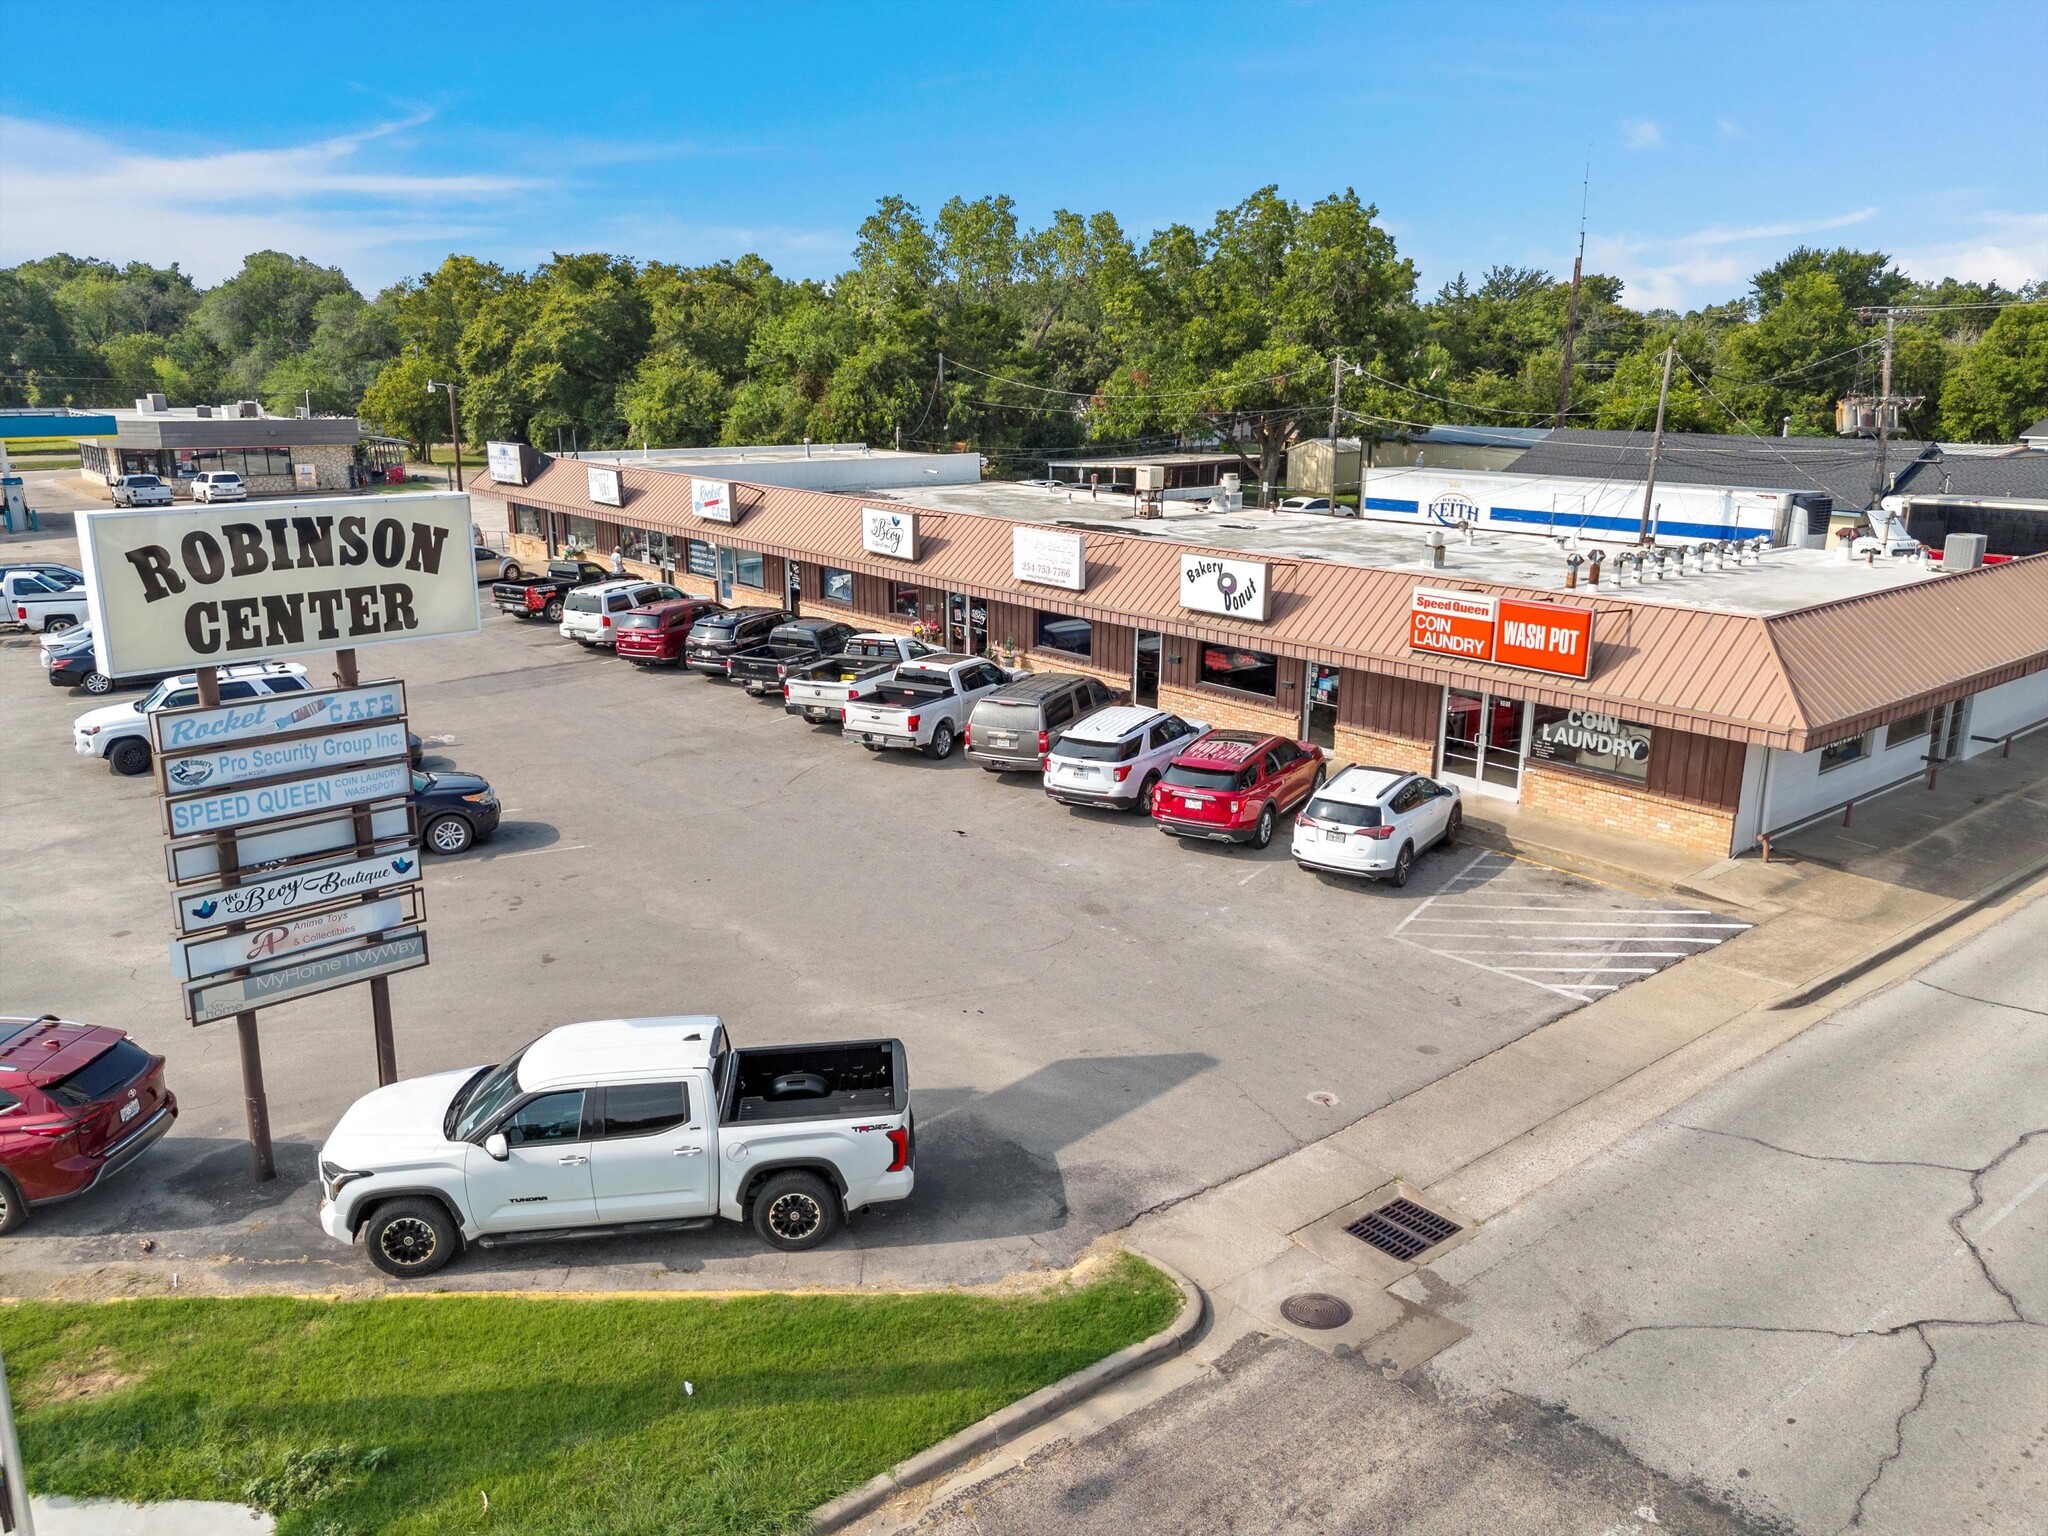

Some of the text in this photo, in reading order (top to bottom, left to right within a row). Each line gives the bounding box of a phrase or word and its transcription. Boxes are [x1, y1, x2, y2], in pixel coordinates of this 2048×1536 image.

[700, 484, 723, 501] Rocket
[1427, 502, 1479, 522] KEITH
[871, 517, 904, 554] Bevy
[125, 515, 449, 603] ROBINSON
[1022, 562, 1071, 578] 254-753-7766
[1186, 561, 1223, 584] Bakery
[1224, 578, 1256, 611] Donut
[1417, 597, 1489, 616] Speed Queen
[184, 583, 419, 655] CENTER
[1415, 614, 1451, 633] COIN
[1414, 630, 1485, 655] LAUNDRY
[1504, 620, 1580, 656] WASH POT
[171, 694, 394, 745] Rocket CAFE
[1567, 709, 1619, 735] COIN
[219, 731, 403, 774] Pro Security Group Inc.
[1542, 723, 1641, 759] LAUNDRY
[335, 767, 401, 787] COIN LAUNDRY
[344, 780, 396, 797] WASHSPOT
[174, 780, 331, 829] SPEED QUEEN
[221, 868, 390, 912] the Bevy Boutique
[293, 912, 348, 931] Anime Toys
[294, 925, 356, 946] & Collectibles
[256, 959, 342, 990] MyHome
[355, 939, 418, 965] MyWay
[206, 1003, 243, 1018] home
[211, 1002, 224, 1010] MY
[851, 1124, 875, 1133] TRD
